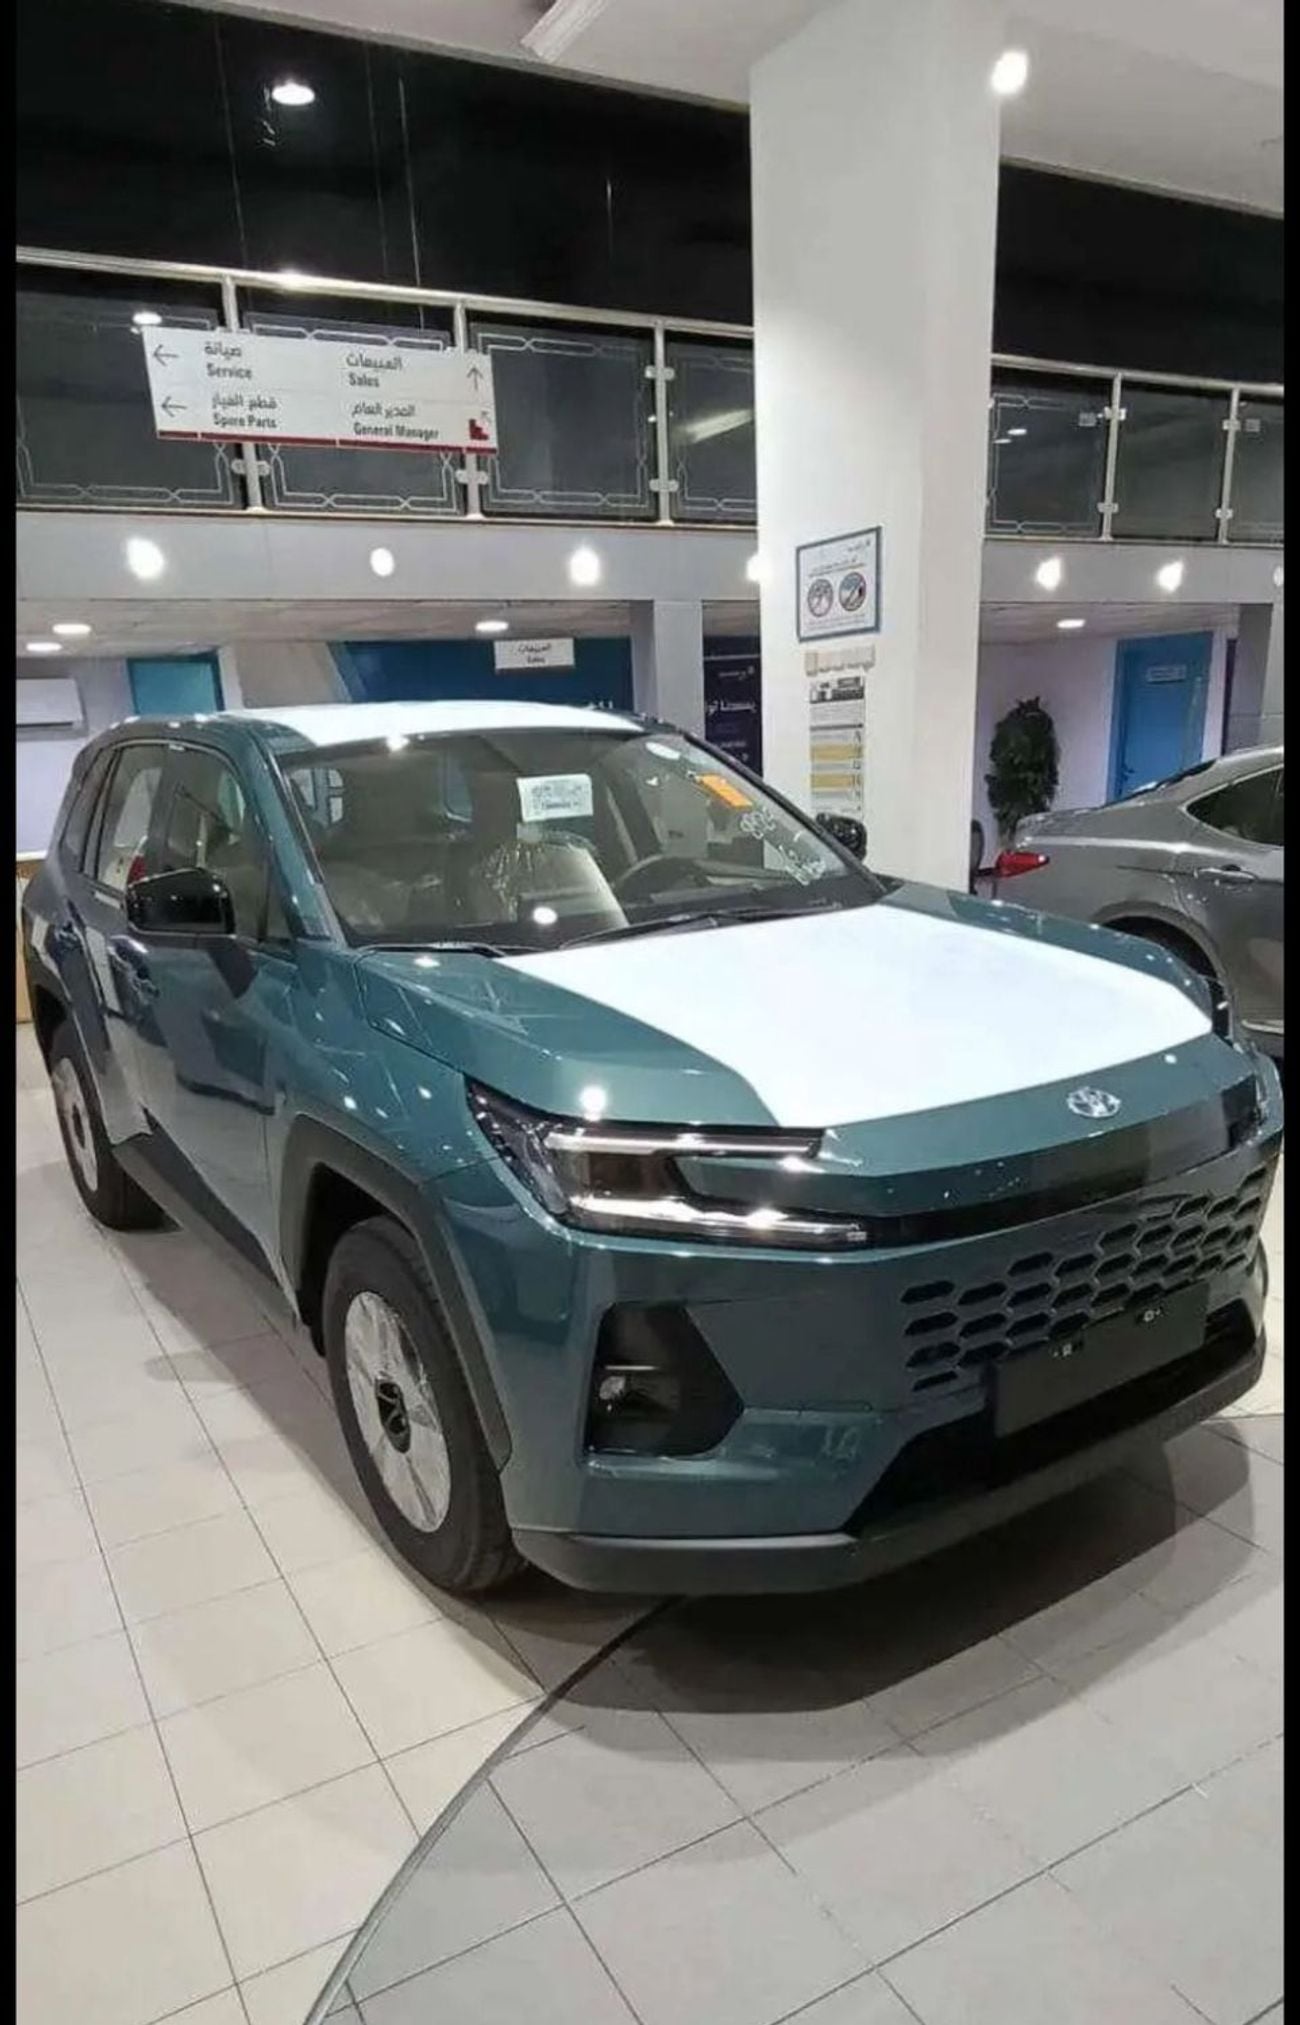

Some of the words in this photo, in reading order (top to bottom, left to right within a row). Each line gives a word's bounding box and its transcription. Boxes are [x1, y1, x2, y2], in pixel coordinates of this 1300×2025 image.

[204, 341, 242, 360] صيانة
[206, 362, 252, 380] Service
[346, 353, 403, 372] المبيعات
[348, 373, 380, 388] Sales
[351, 402, 383, 418] العام
[384, 404, 416, 419] المدير
[213, 412, 246, 428] Spare
[247, 414, 278, 428] Parts
[353, 422, 393, 436] General
[395, 425, 439, 441] Manager
